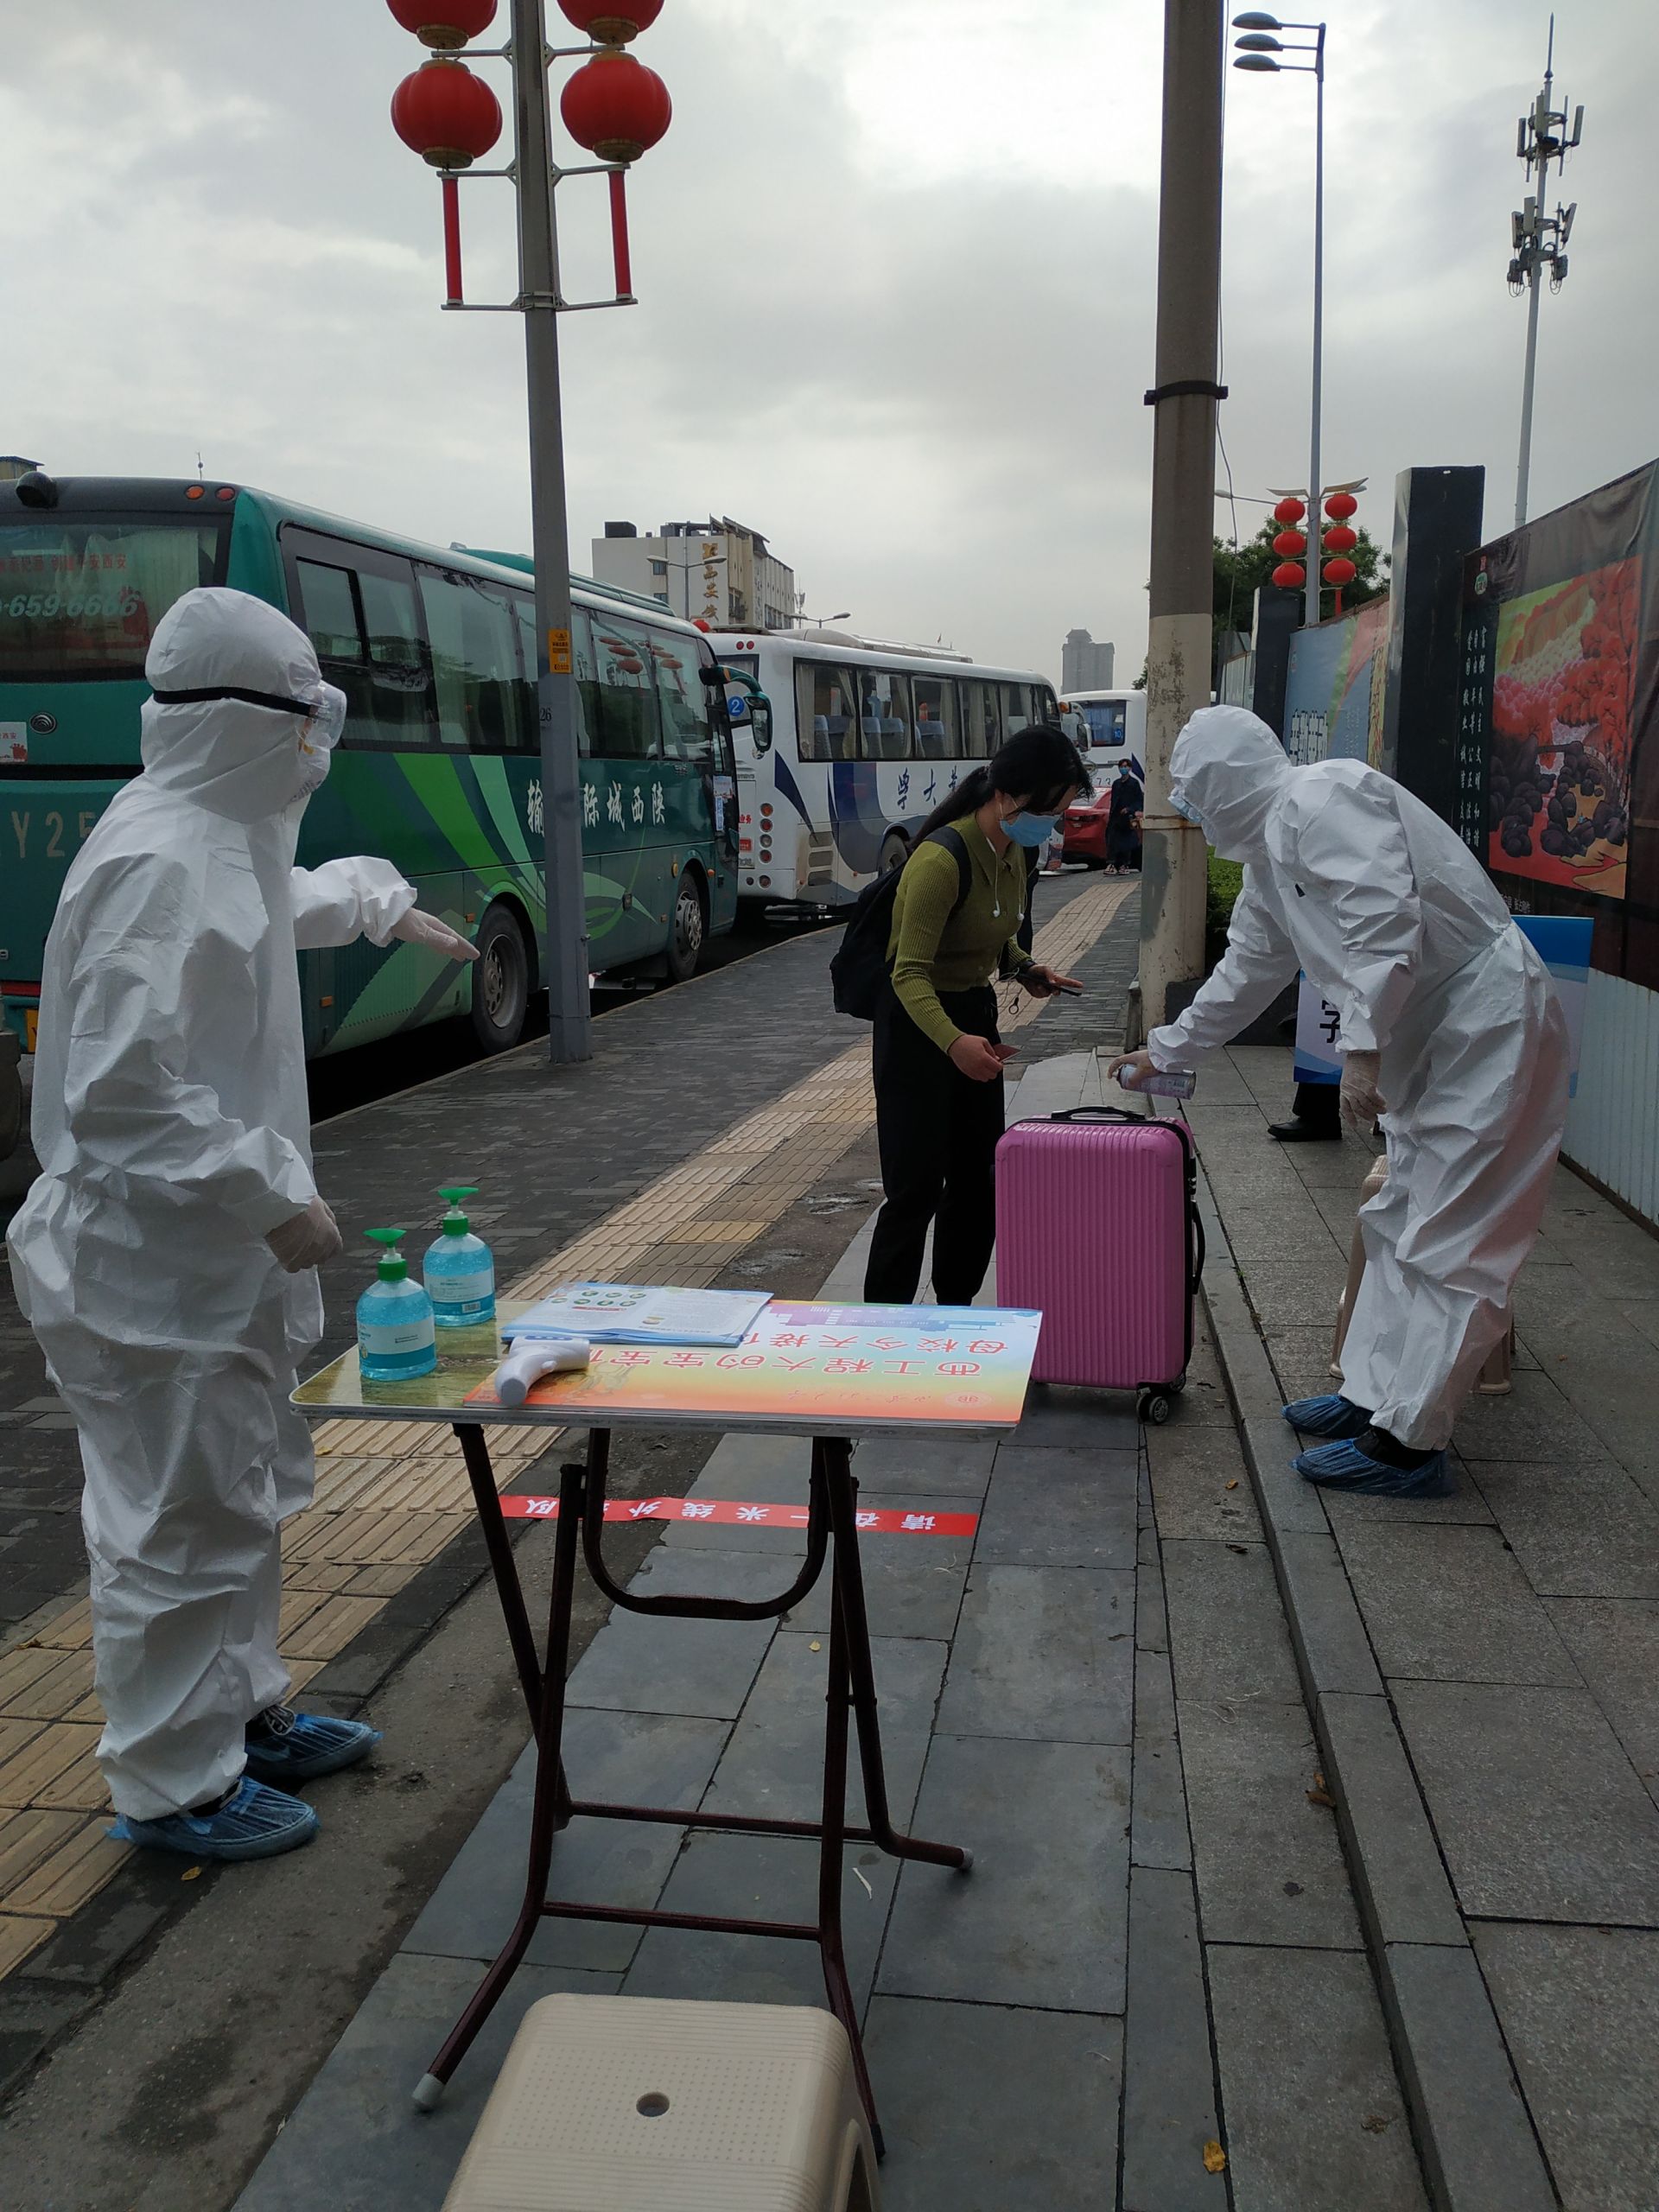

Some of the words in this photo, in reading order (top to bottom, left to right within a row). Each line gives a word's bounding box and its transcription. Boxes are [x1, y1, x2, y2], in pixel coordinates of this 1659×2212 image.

[0, 594, 139, 617] -659-6666
[731, 699, 741, 714] 2
[525, 1498, 936, 1530] 请在一米线外队
